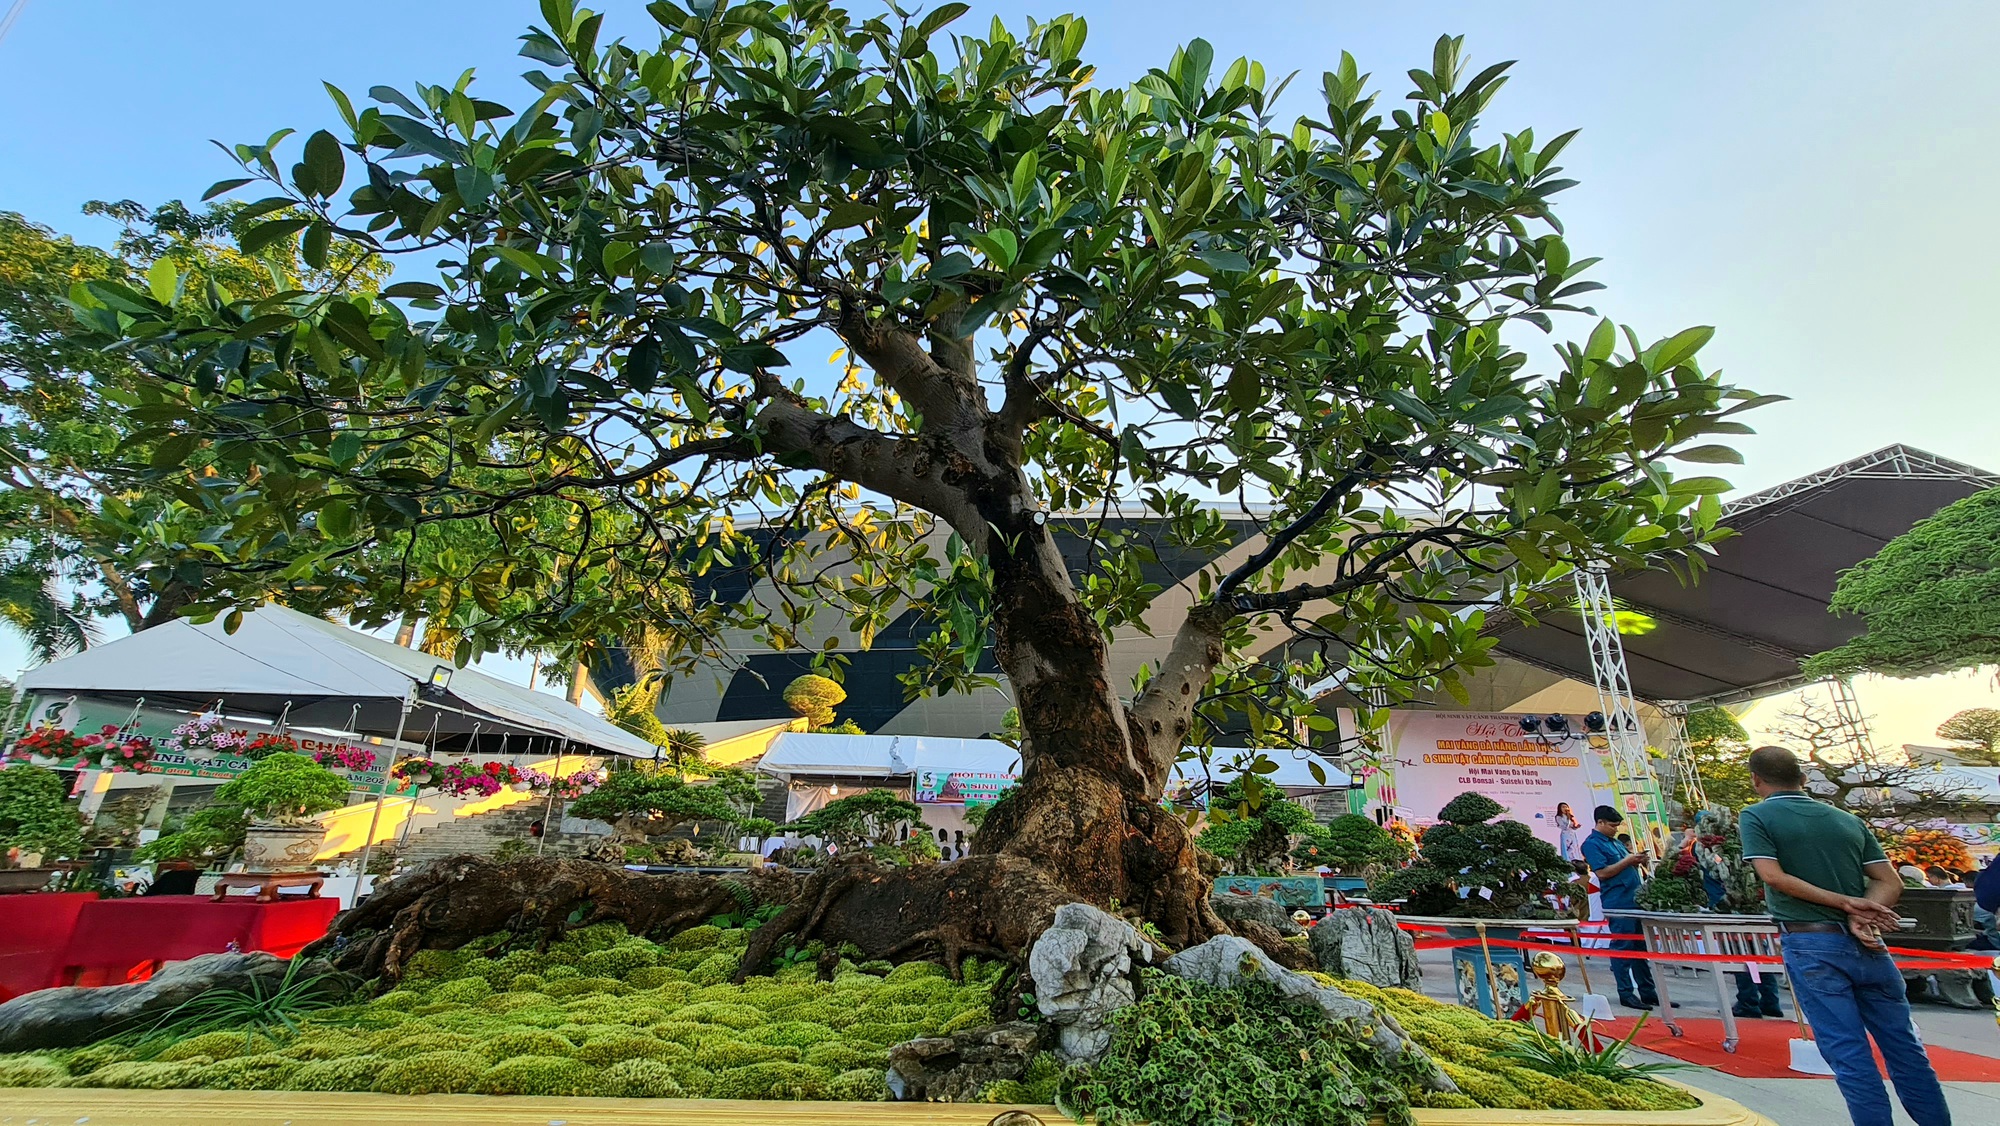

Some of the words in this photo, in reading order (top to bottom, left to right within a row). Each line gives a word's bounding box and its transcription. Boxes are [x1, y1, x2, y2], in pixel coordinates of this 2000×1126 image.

[1437, 740, 1454, 750] MAI
[1455, 739, 1479, 750] VÀNG
[1480, 740, 1492, 751] ĐÀ
[153, 753, 187, 764] INH
[1423, 753, 1431, 763] &
[1432, 754, 1454, 764] SINH
[1454, 753, 1470, 766] VẬT
[1471, 752, 1496, 764] CẢNH
[1496, 753, 1511, 765] MỞ
[1512, 754, 1536, 767] RỘNG
[1537, 755, 1557, 767] NĂM
[1558, 757, 1579, 768] 2023
[970, 783, 998, 791] SINH
